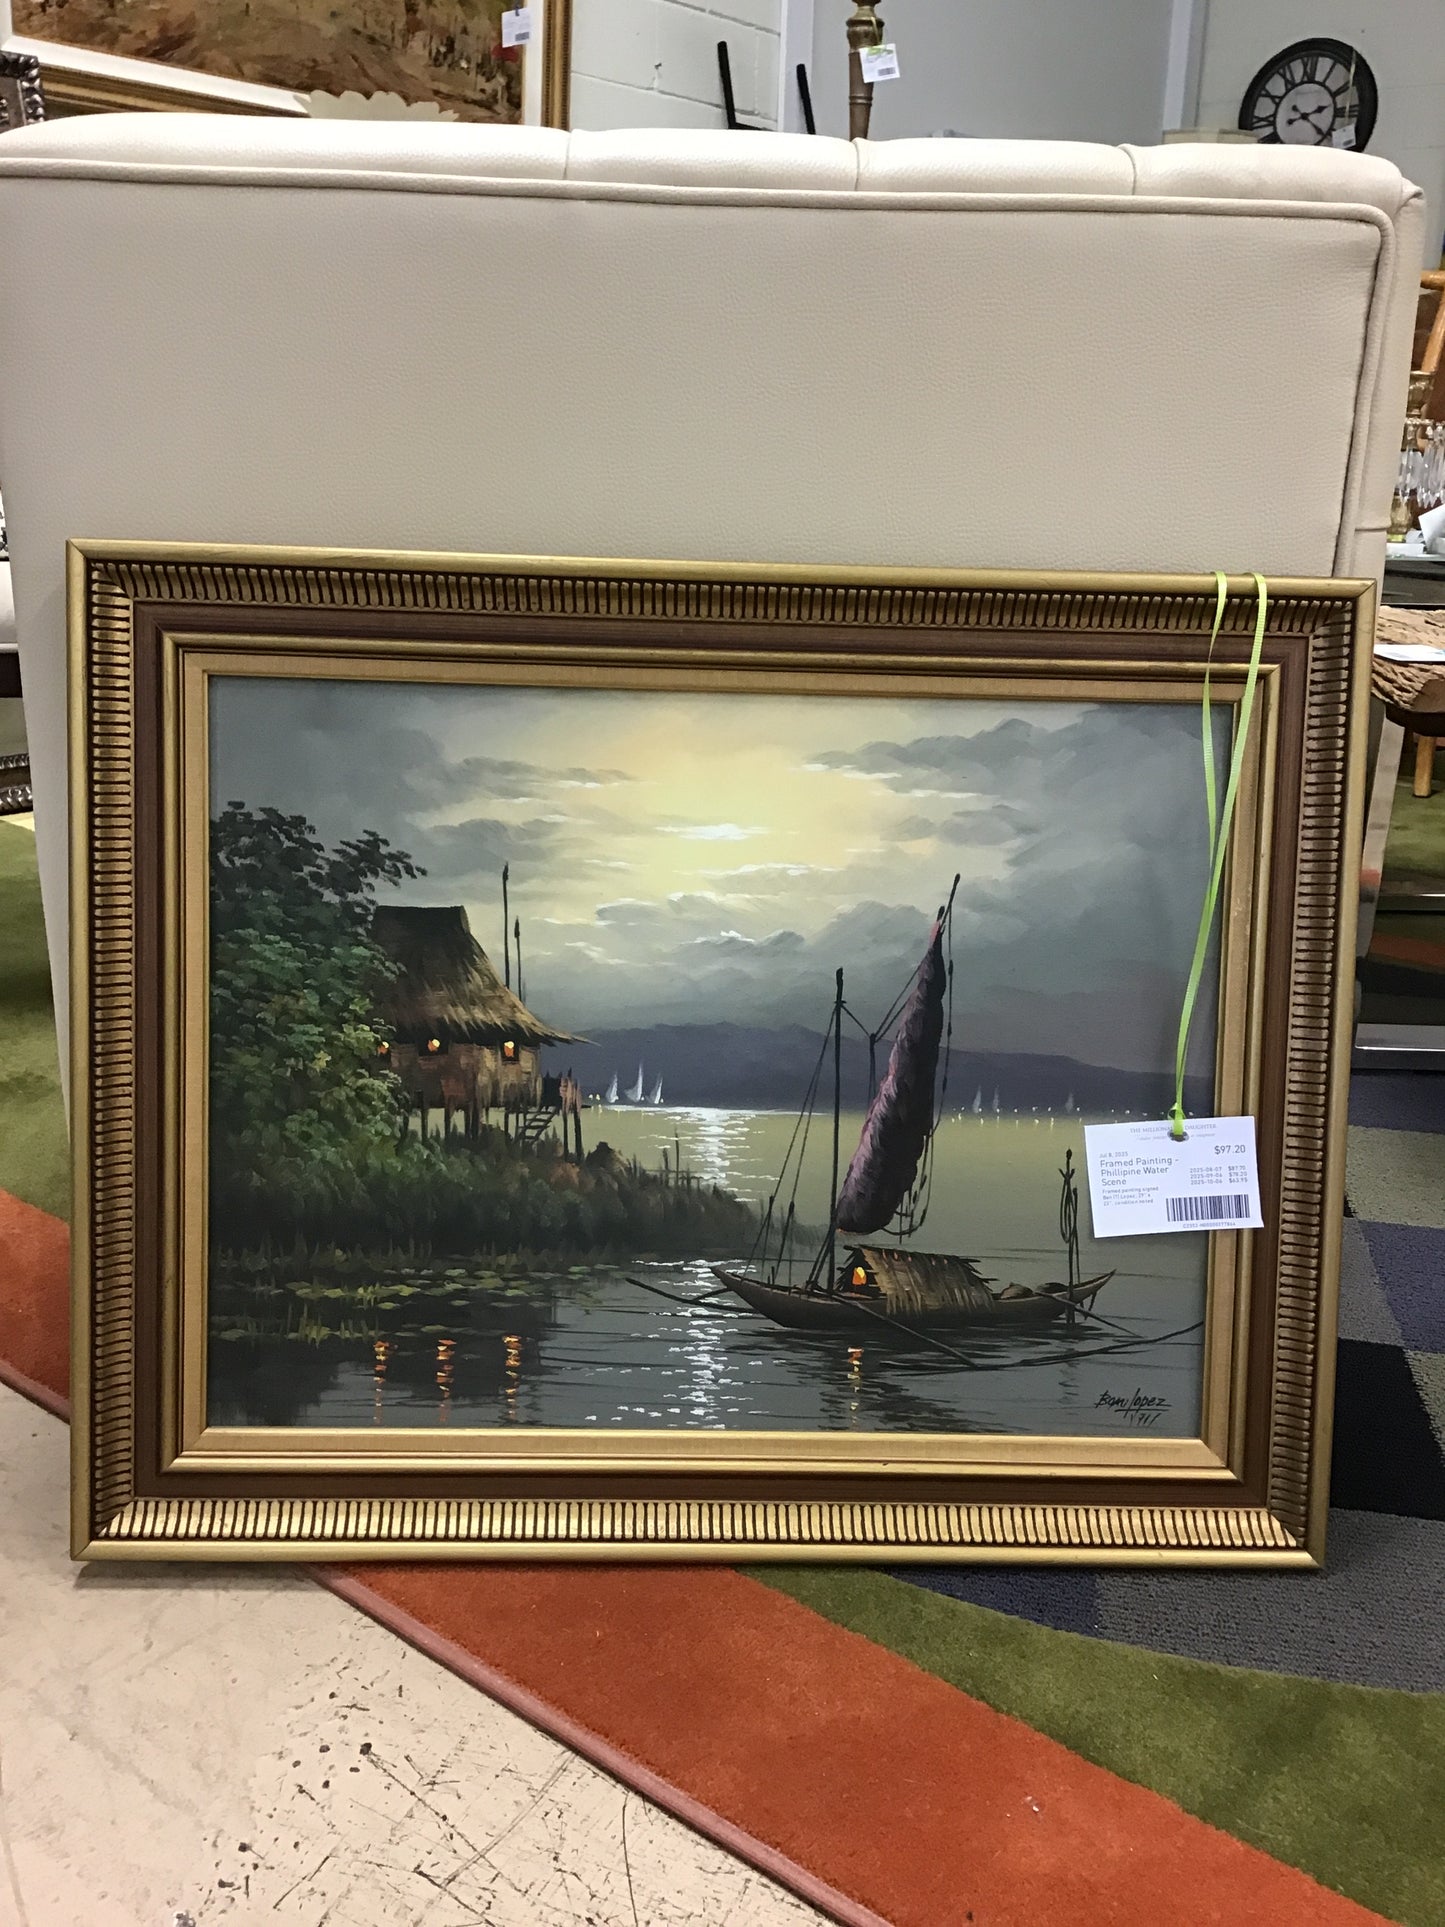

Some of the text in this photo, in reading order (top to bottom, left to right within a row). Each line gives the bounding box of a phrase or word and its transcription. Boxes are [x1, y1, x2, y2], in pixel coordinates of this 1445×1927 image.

[1214, 1144, 1246, 1155] $97.20
[1100, 1158, 1134, 1168] Framed
[1135, 1157, 1173, 1166] Painting
[1101, 1166, 1169, 1177] Phillipine Water
[1101, 1178, 1127, 1186] Scene
